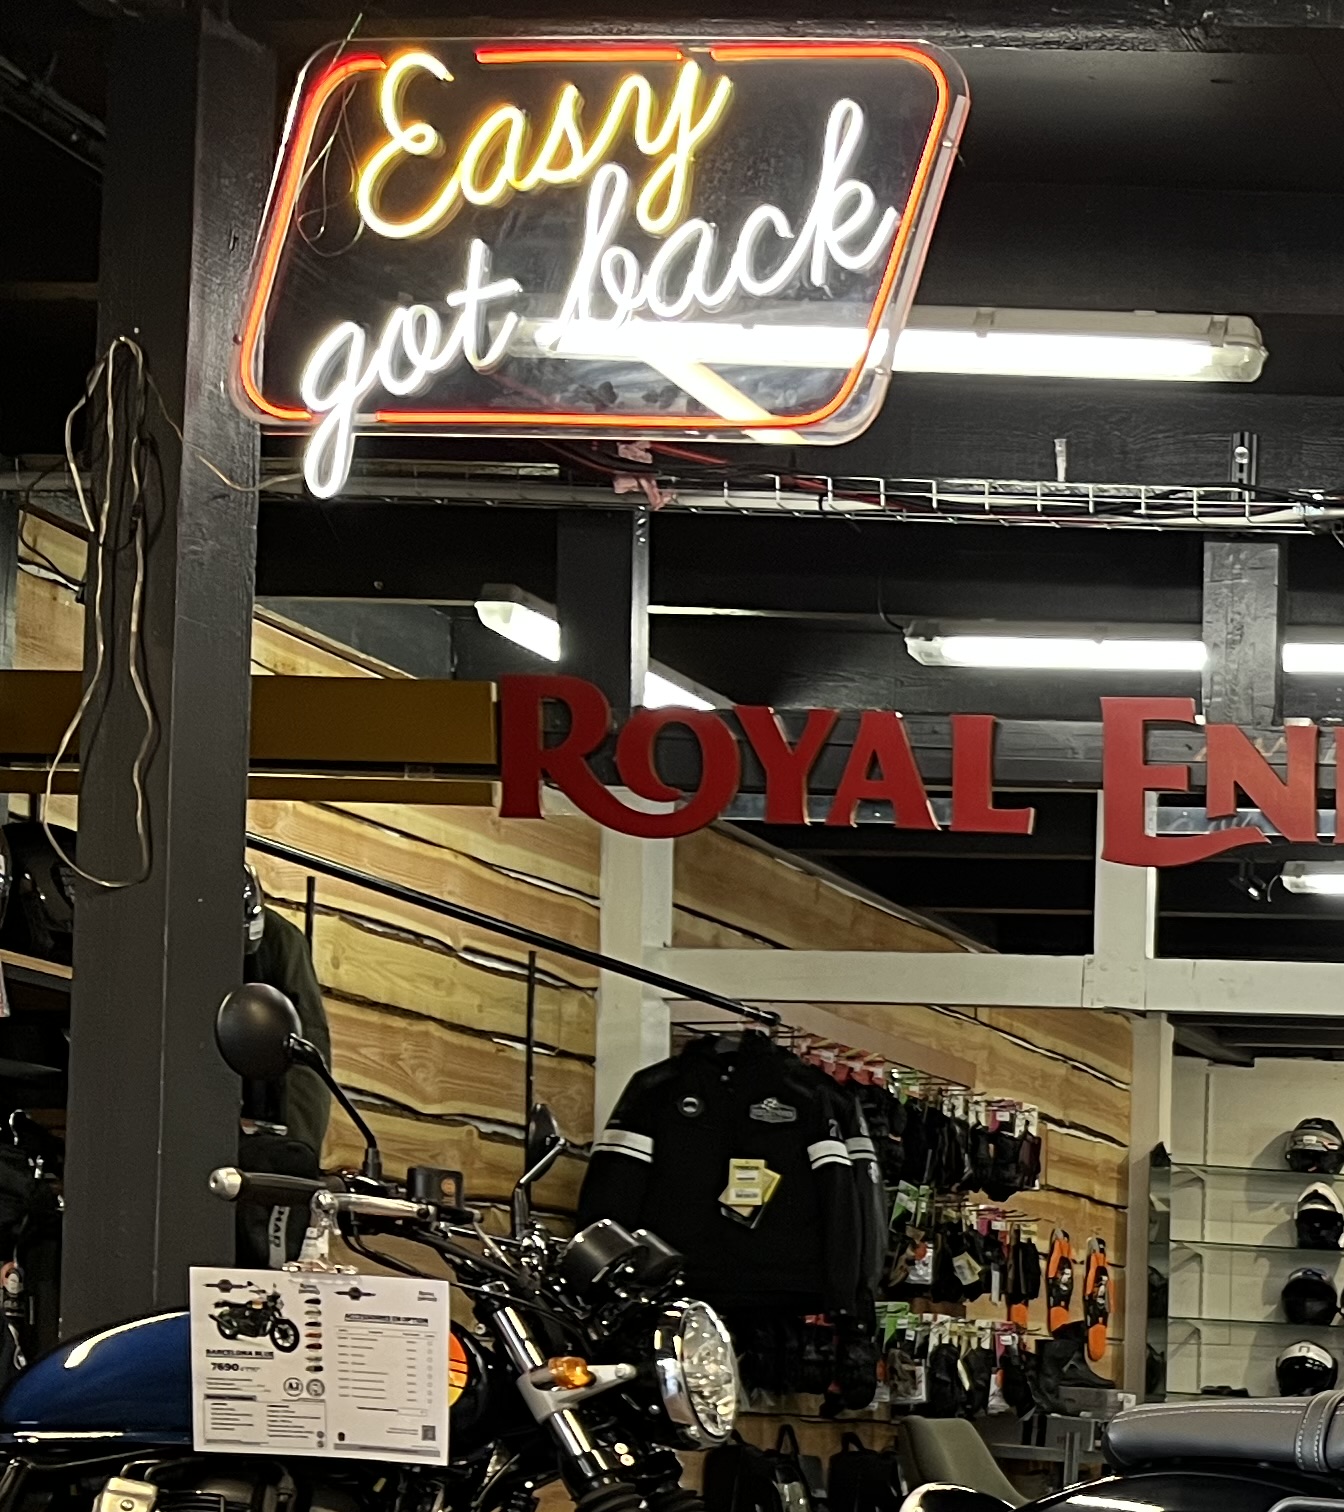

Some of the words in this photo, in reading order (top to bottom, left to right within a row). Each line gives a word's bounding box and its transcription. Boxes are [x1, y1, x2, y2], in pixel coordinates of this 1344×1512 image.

[355, 51, 732, 239] Easy
[301, 238, 521, 498] got
[547, 97, 896, 345] back
[498, 673, 1036, 839] ROYAL
